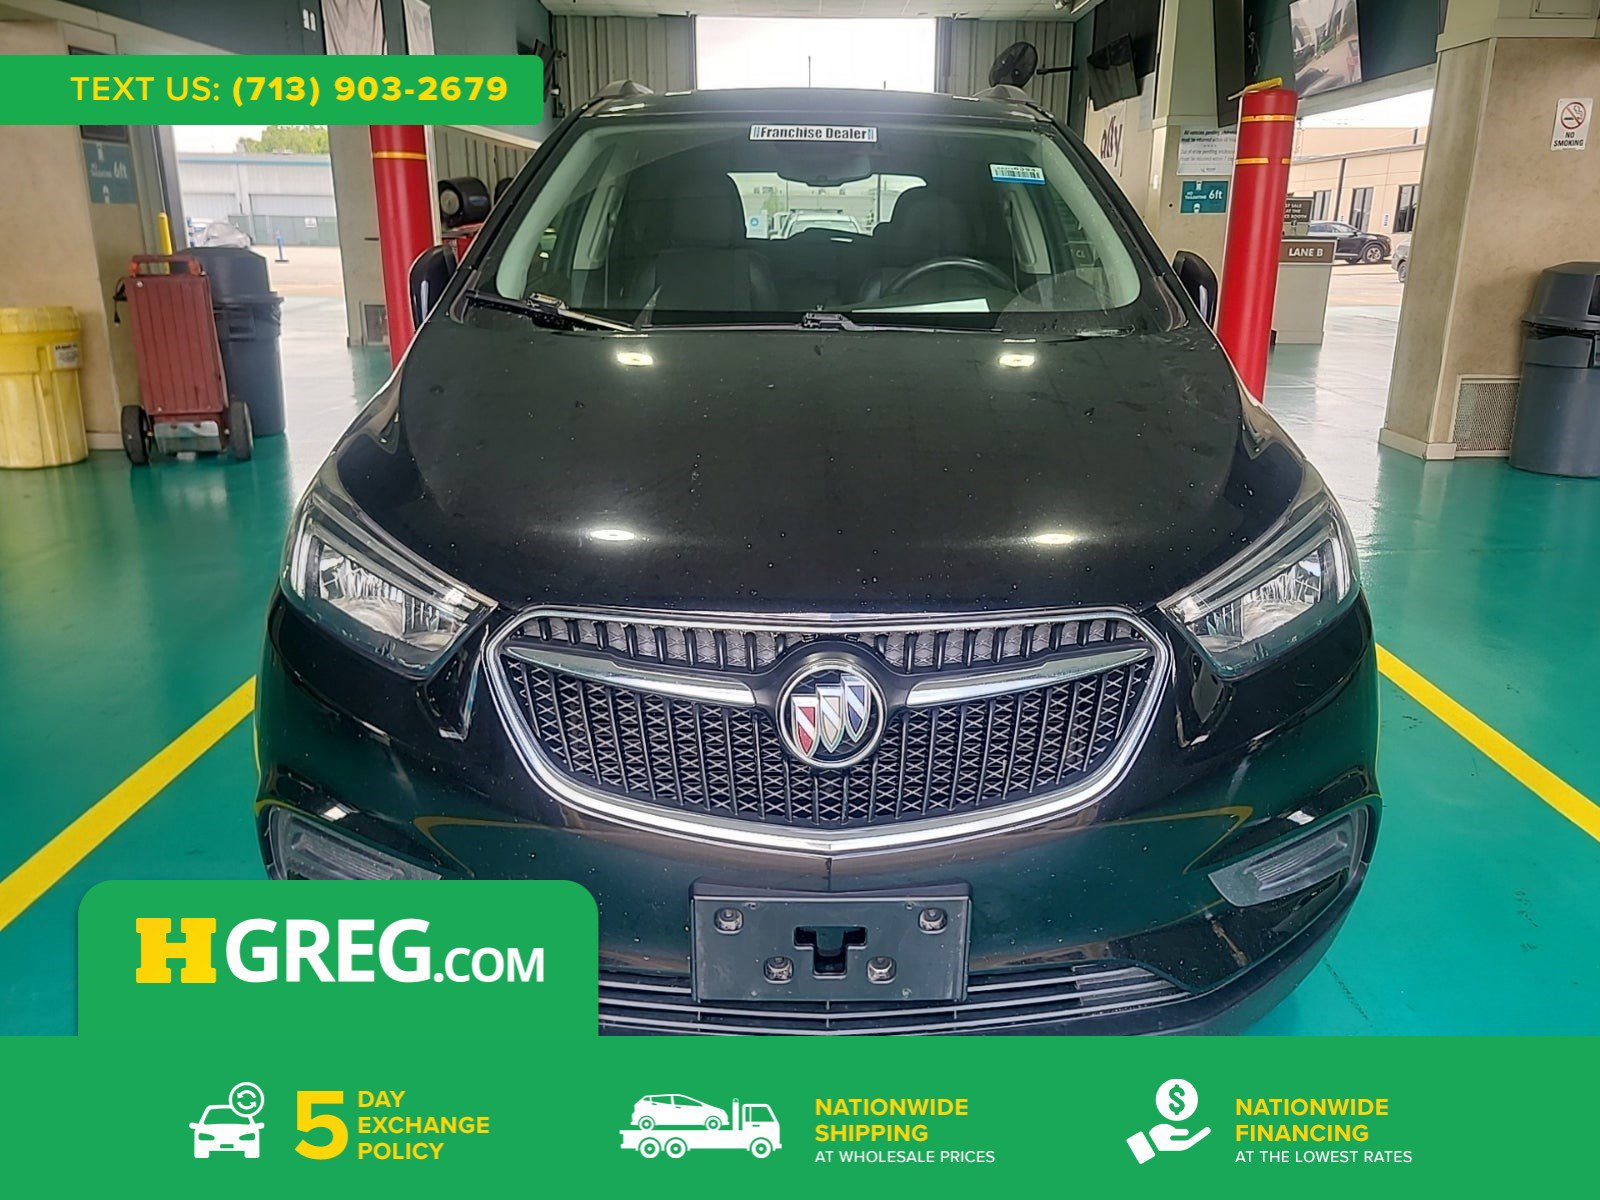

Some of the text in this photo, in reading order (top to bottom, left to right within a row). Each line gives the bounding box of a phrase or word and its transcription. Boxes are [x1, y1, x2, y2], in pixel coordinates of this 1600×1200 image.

[760, 126, 867, 140] Franchise Dealer
[1553, 139, 1584, 147] SMOKING
[1208, 189, 1223, 200] 6ft
[1288, 247, 1314, 257] LANE
